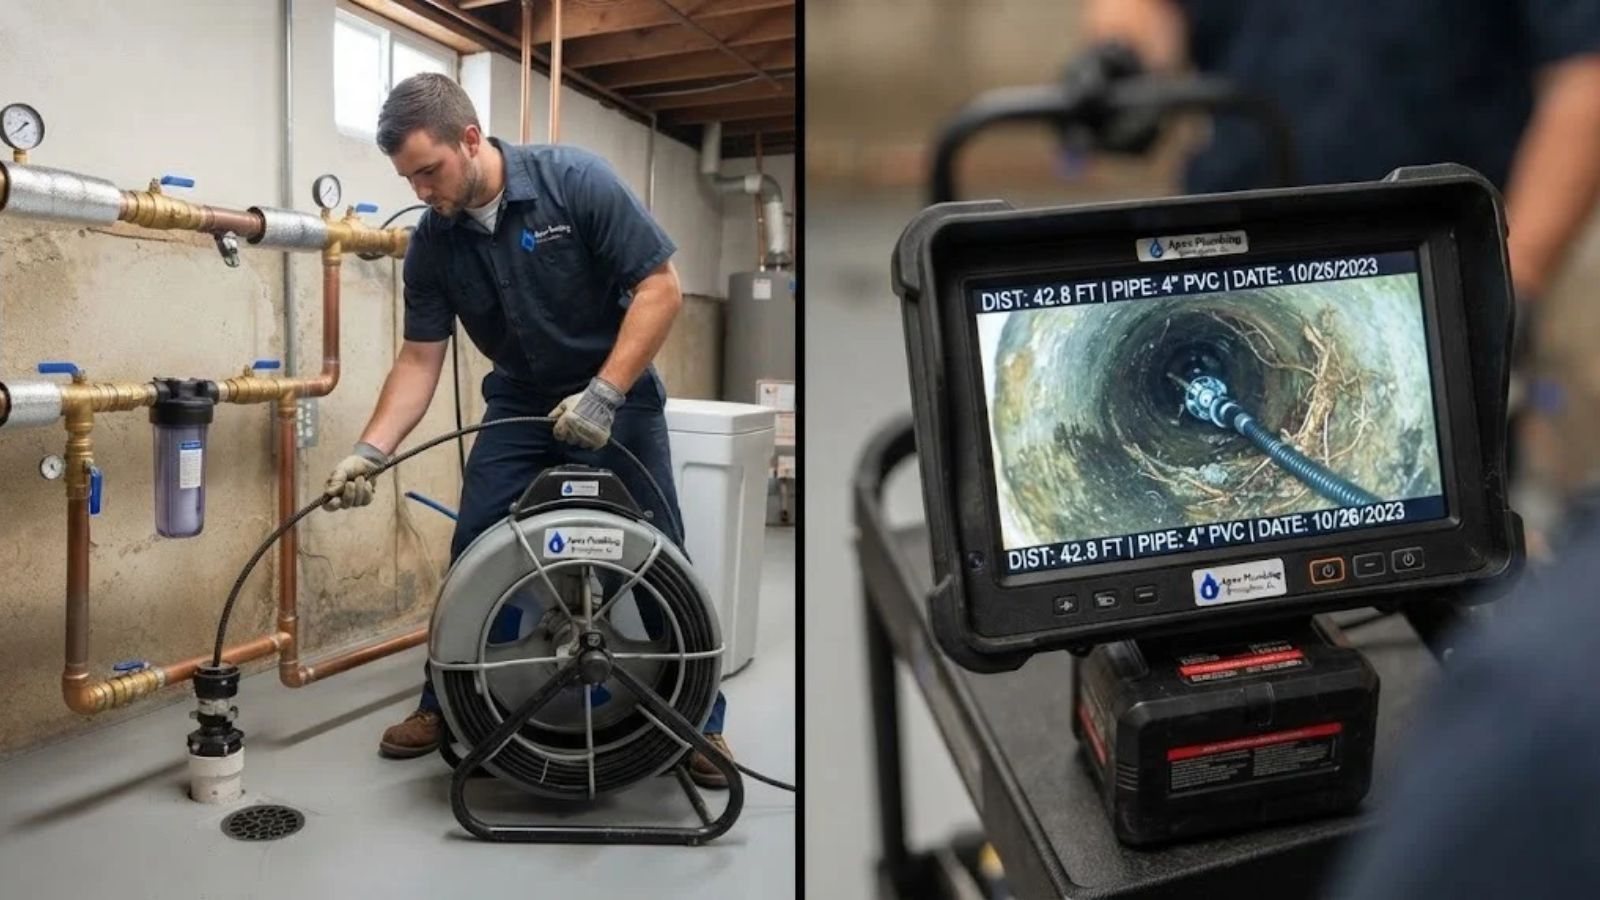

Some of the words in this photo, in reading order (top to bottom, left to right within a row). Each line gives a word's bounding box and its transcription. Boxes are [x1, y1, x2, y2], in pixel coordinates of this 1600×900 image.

[981, 289, 1030, 311] DIST:
[1033, 285, 1071, 306] 42.8
[1075, 283, 1098, 303] FT
[1111, 278, 1158, 299] PIPE:
[1161, 275, 1179, 294] 4"
[1183, 272, 1220, 292] PVC
[1233, 267, 1284, 288] DATE:
[1008, 547, 1056, 570] DIST:
[1060, 541, 1097, 563] 42.8
[1101, 538, 1123, 557] FT
[1138, 530, 1184, 553] PIPE:
[1186, 527, 1205, 546] 4"
[1208, 522, 1245, 544] PVC
[1258, 515, 1309, 538] DATE:
[1312, 502, 1405, 531] 10/26/2023
